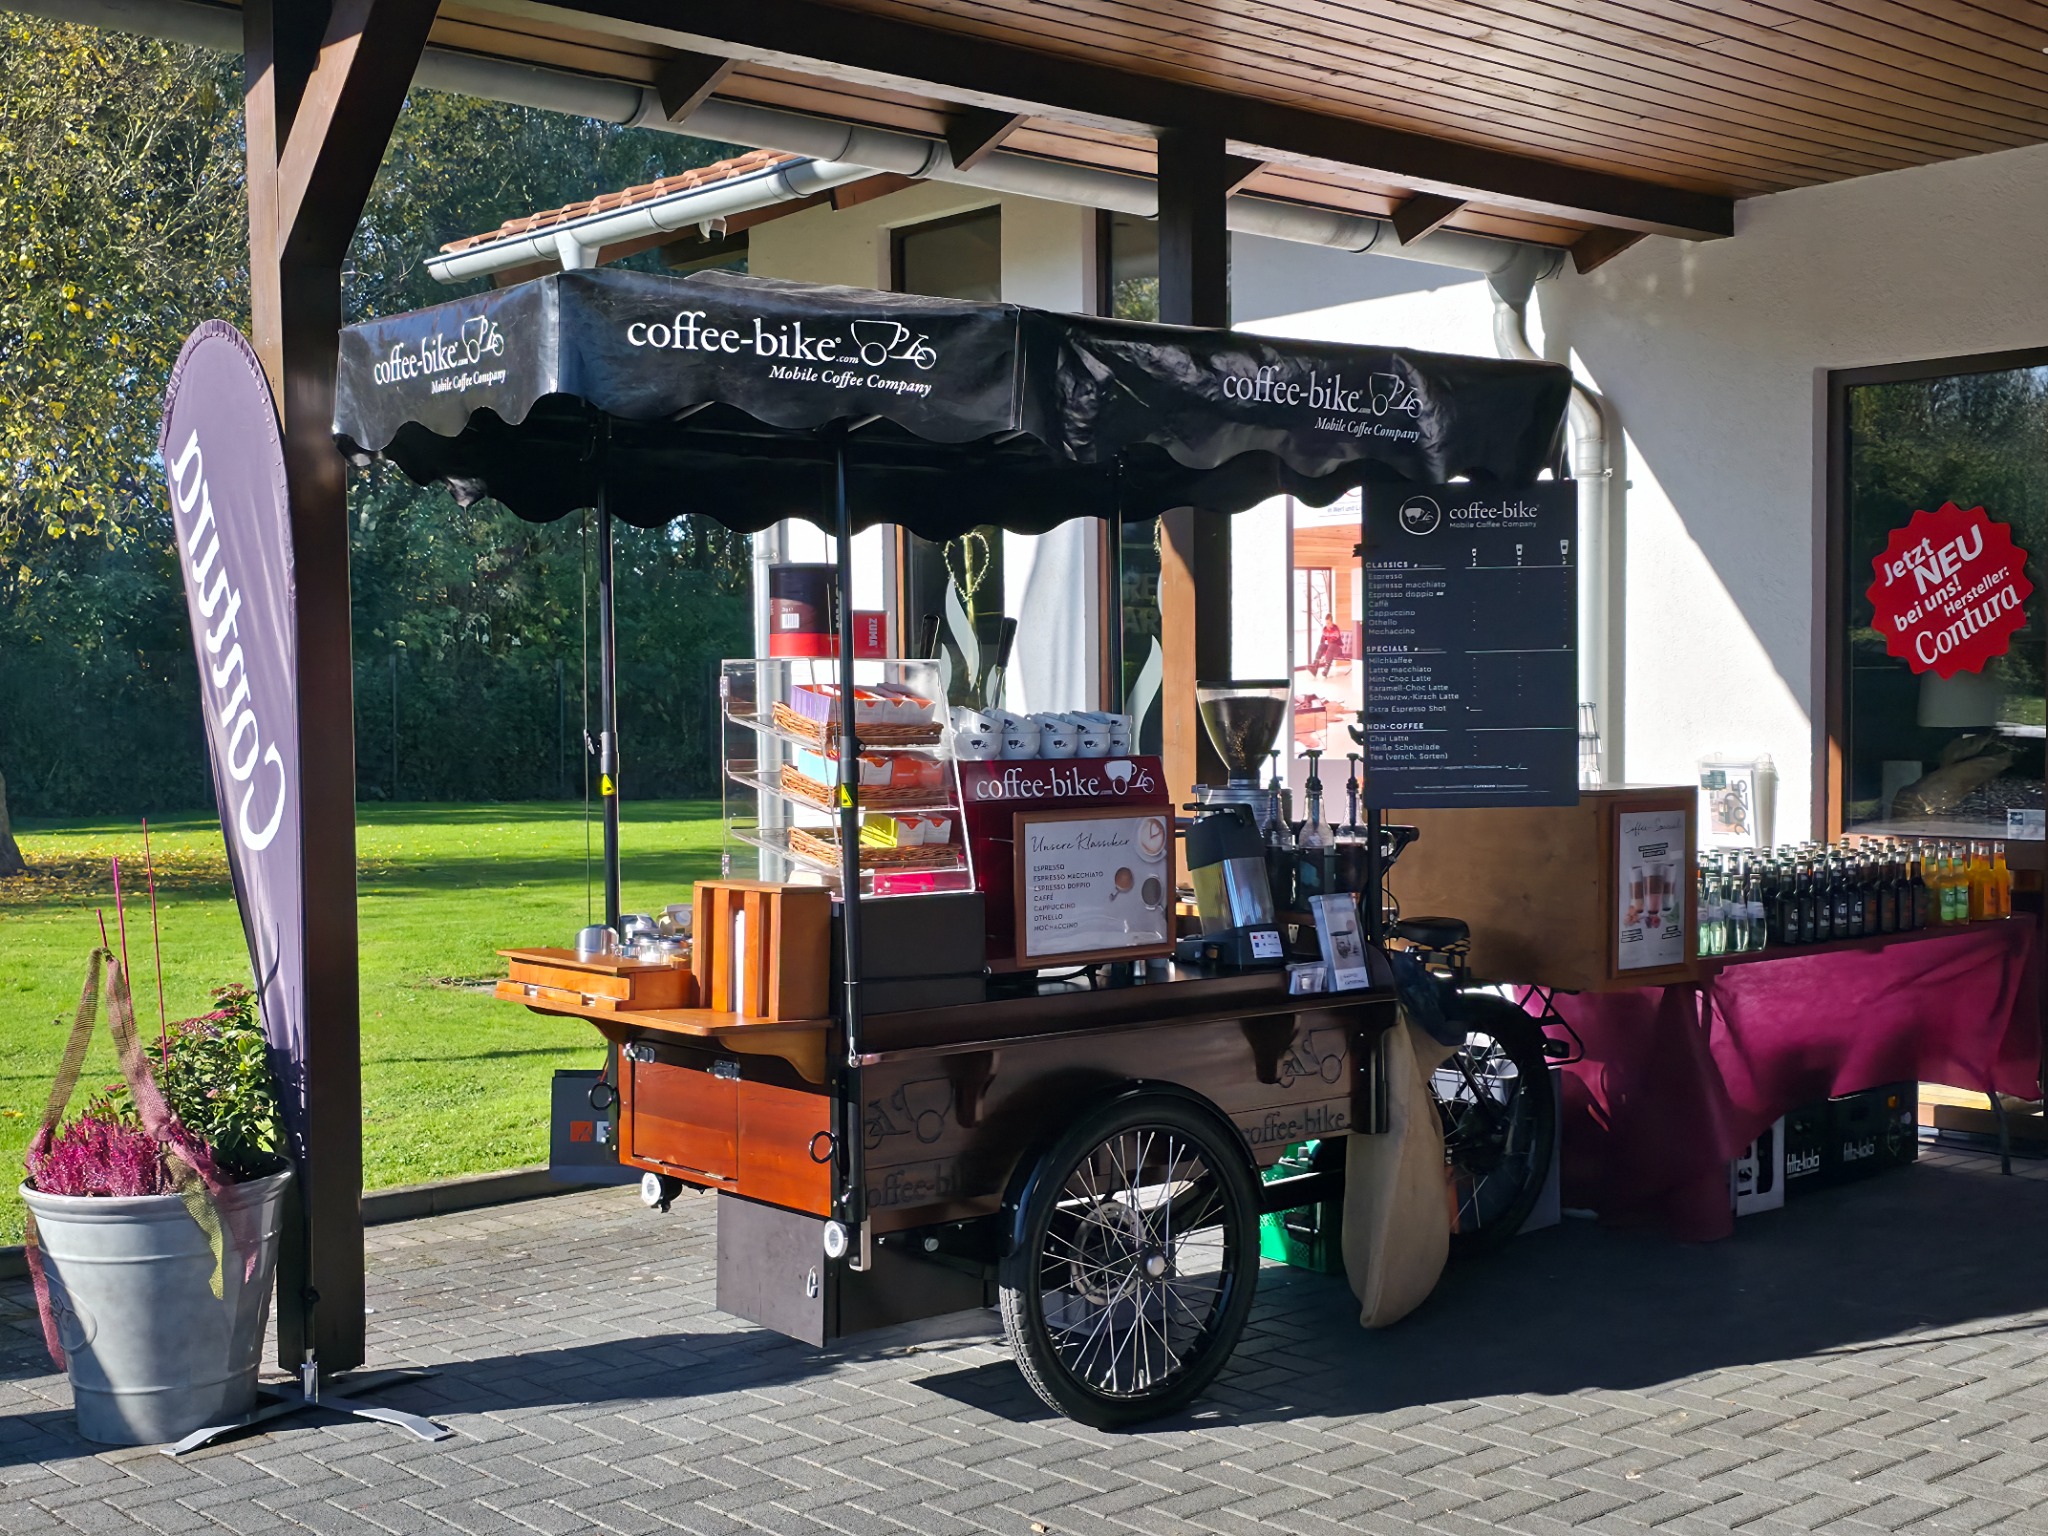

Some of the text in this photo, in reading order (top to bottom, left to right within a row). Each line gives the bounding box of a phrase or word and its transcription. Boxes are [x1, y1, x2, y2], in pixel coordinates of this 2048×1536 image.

[628, 310, 843, 362] coffee-bike
[373, 334, 459, 385] coffee-bike
[431, 369, 506, 394] Mobile Coffee Company
[768, 365, 932, 397] Mobile Coffee Company
[1222, 365, 1362, 414] coffee-bike
[1314, 416, 1421, 443] Mobile Coffee Company
[1449, 501, 1538, 519] coffee-bike
[1449, 519, 1537, 529] Mobile Coffee Company
[1365, 561, 1408, 569] CLASSICS
[1883, 537, 1934, 587] Jetzt
[1913, 524, 1984, 595] NEU
[1368, 572, 1404, 581] Espresso
[1368, 580, 1447, 591] Espresso macchiato
[1368, 589, 1435, 600] Espresso doppio
[1943, 566, 2010, 617] Hersteller:
[1893, 574, 1963, 632] bei uns!
[1368, 608, 1415, 618] Cappuccino
[1368, 617, 1397, 626] Othello
[1915, 584, 2022, 665] Contura
[868, 618, 879, 647] ZUMA
[1368, 626, 1415, 635] Mochaccino
[1365, 645, 1408, 654] SPECIALS
[1368, 655, 1413, 665] Milchkaffee
[1368, 664, 1432, 675] Latte macchiato
[1368, 673, 1432, 684] Mint-Choc Latte
[1368, 682, 1449, 693] Karamell-Choc Latte
[1439, 691, 1460, 701] Latte
[1368, 703, 1447, 715] Extra Espresso Shot
[1366, 723, 1425, 731] NON-COFFEE
[1369, 733, 1410, 743] Chai Latte
[1369, 741, 1441, 752] Heiße Schokolade
[1369, 750, 1449, 761] Tee (versch. Sorten)
[976, 767, 1101, 799] coffee-bike
[1030, 832, 1130, 853] Unsere Klassiker
[1033, 864, 1065, 872] ESPRESSO
[1033, 871, 1104, 882] ESPRESSO MACCHIATO
[1033, 882, 1091, 892] ESPRESSO DOPPIO
[1033, 903, 1076, 912] CAPPUCCINO
[1033, 913, 1063, 922] OTHELLO
[1033, 922, 1079, 932] MOCHACCINO
